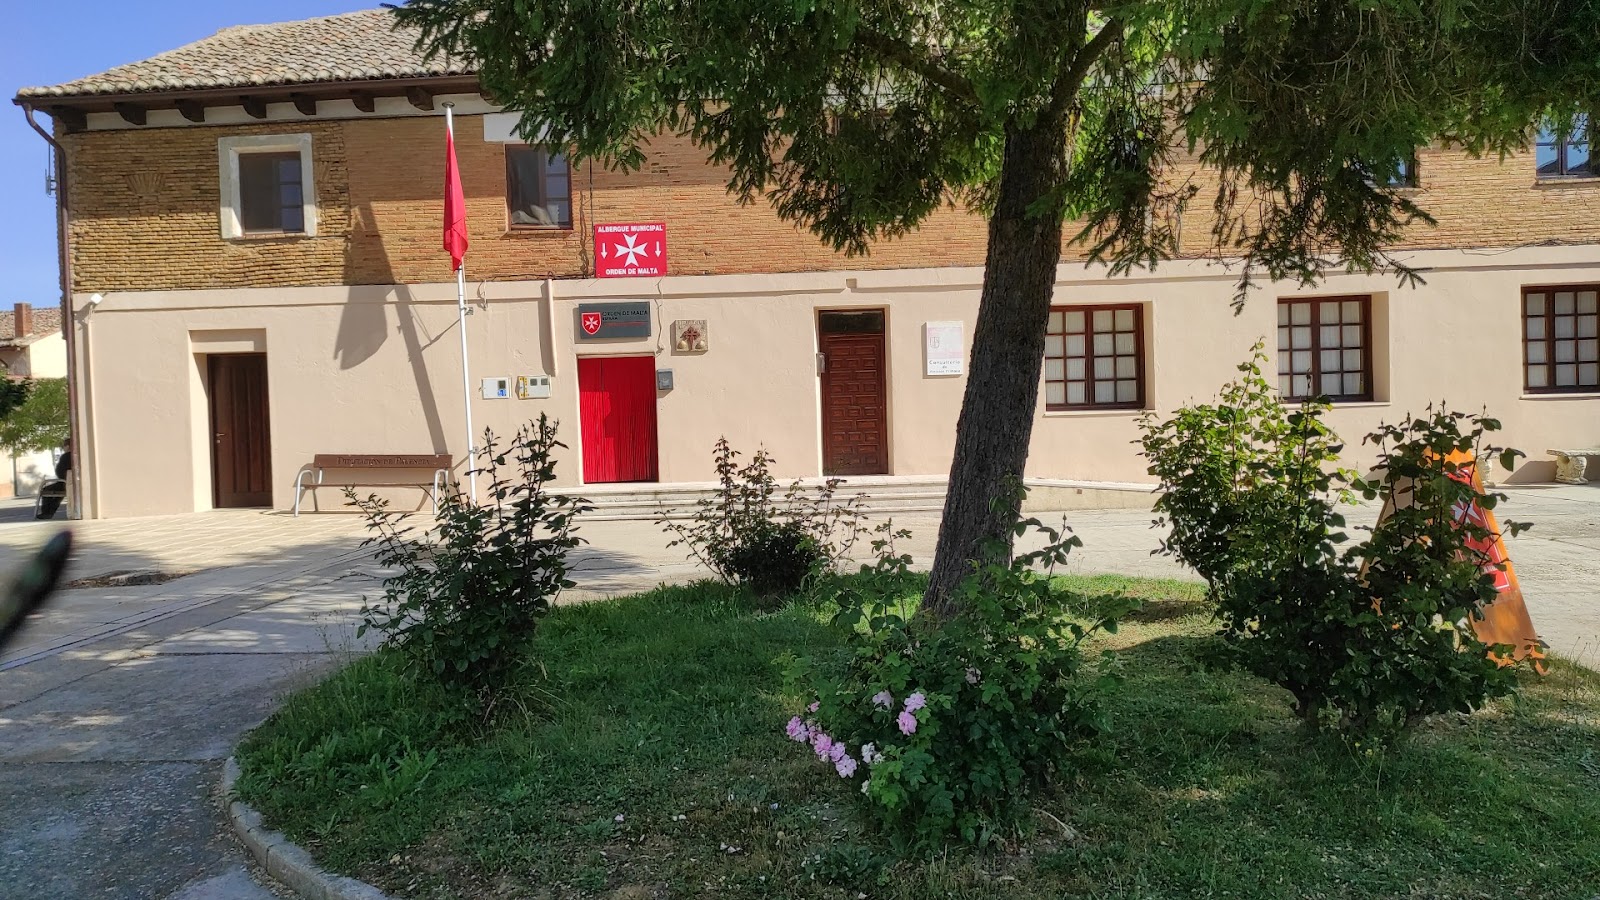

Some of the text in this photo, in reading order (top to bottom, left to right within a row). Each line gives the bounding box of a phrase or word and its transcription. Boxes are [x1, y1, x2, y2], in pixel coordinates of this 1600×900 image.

[598, 224, 663, 233] ALBERGUE MUNICIPAL
[637, 267, 658, 275] MALTA
